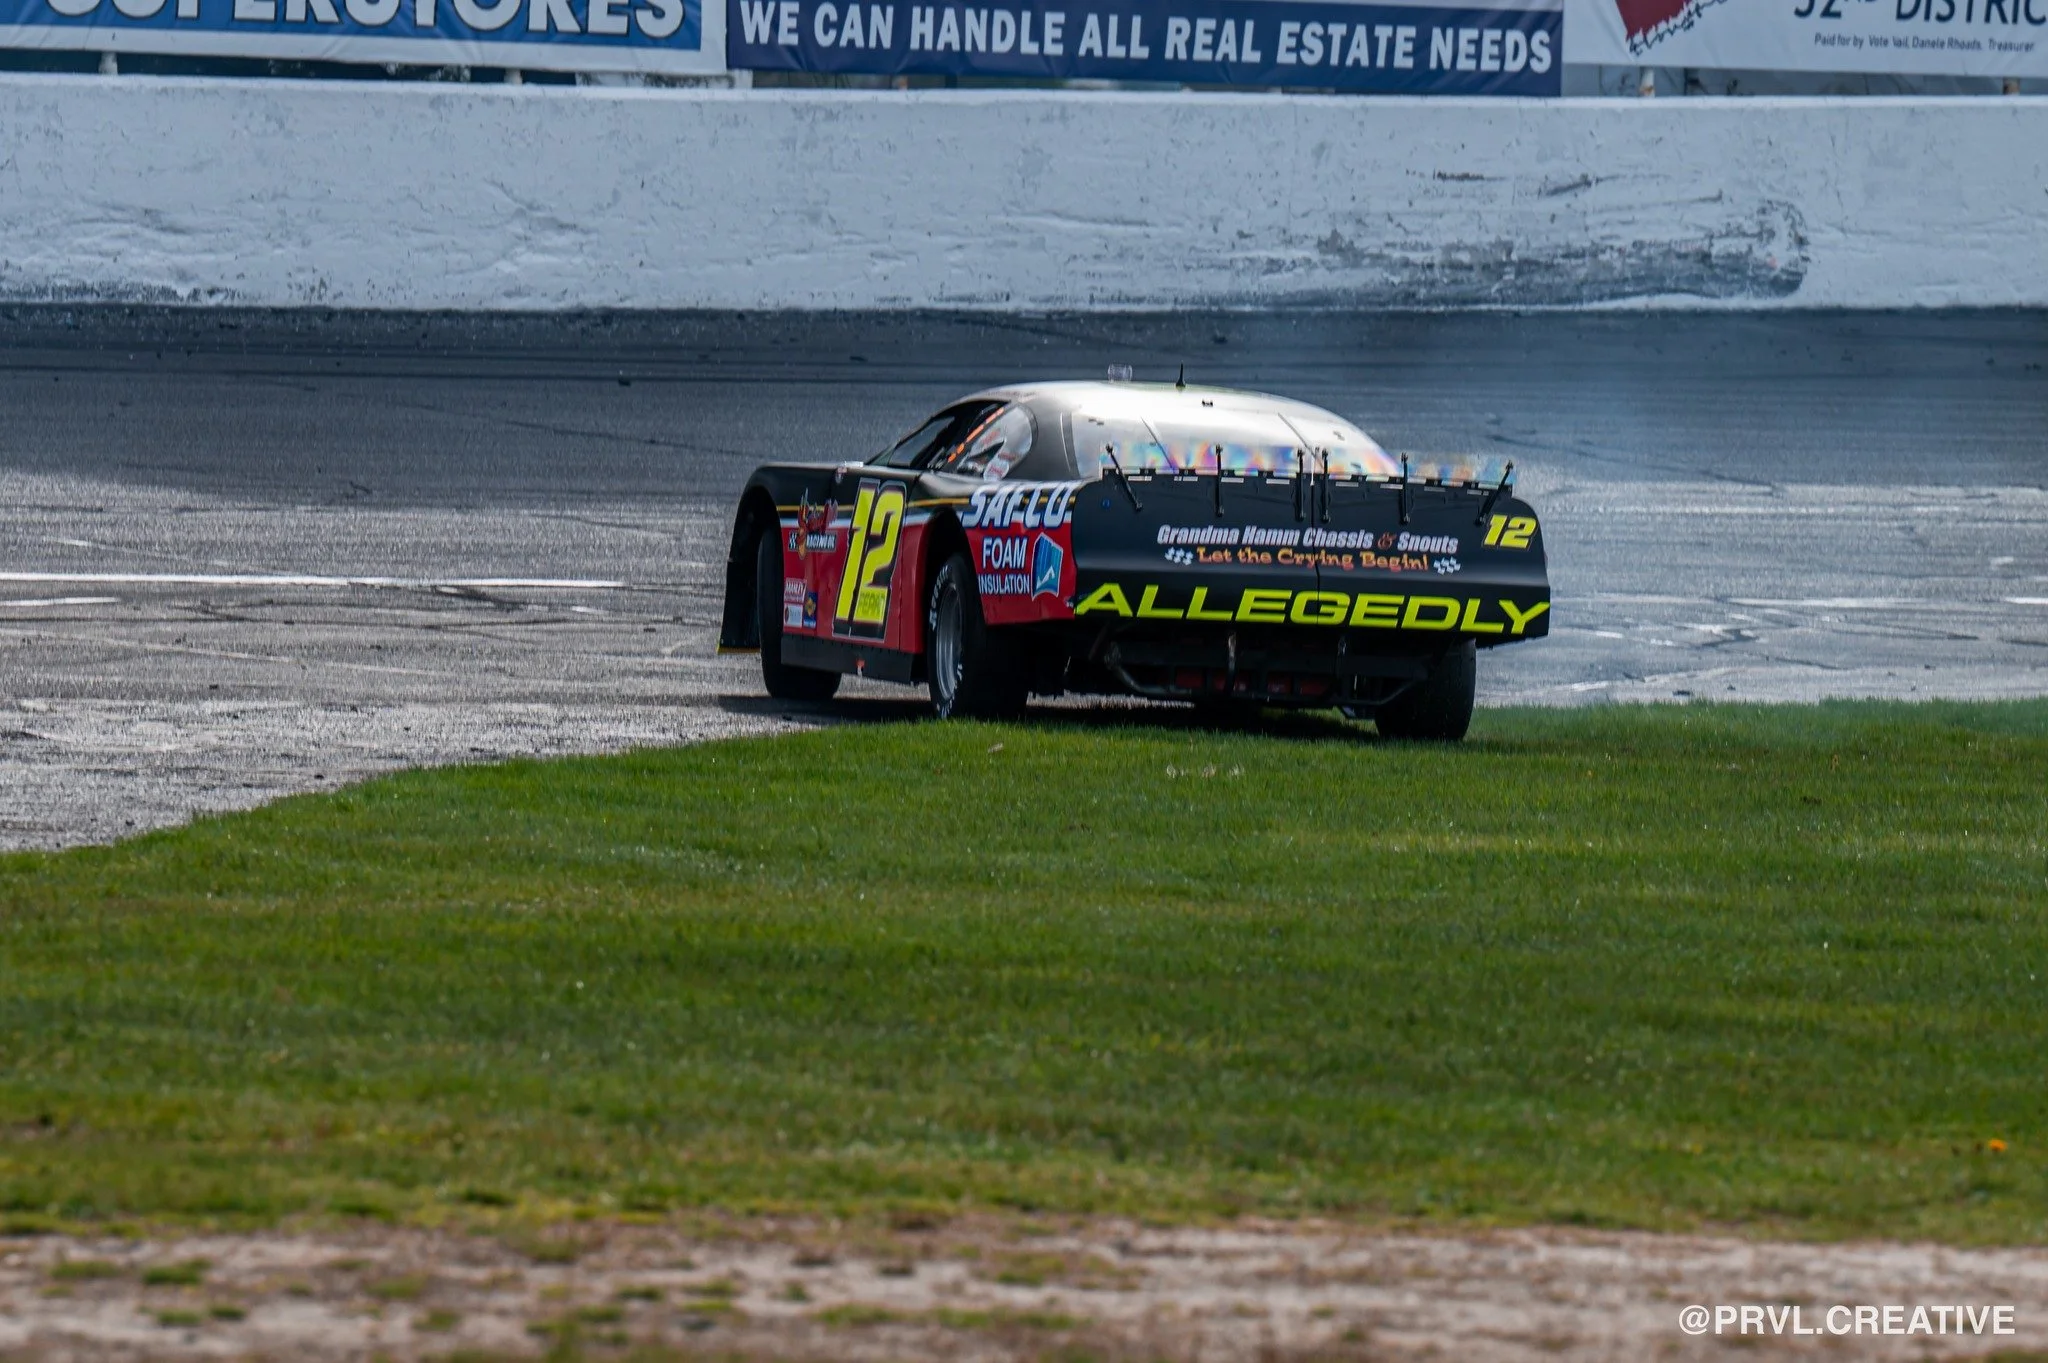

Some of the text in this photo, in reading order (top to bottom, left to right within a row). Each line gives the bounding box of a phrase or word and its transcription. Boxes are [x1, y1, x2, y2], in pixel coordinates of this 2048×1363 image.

[739, 0, 799, 46] WE
[813, 2, 894, 49] CAN
[910, 6, 1066, 56] HANDLE
[1078, 13, 1150, 59] ALL
[1164, 17, 1262, 63] REAL
[1276, 21, 1417, 69] ESTATE
[1429, 26, 1552, 74] NEEDS
[1814, 32, 1836, 47] Paid
[1837, 33, 1851, 47] for
[1852, 34, 1865, 50] by
[1868, 34, 1889, 48] Vote
[1156, 524, 1459, 554] Grandma Hamm Chassis & Snouts
[1483, 513, 1538, 550] 12
[834, 486, 906, 627] 12
[982, 537, 1028, 569] FOAM
[1196, 546, 1429, 573] Let the Crying Begin!
[978, 573, 1030, 594] INSULATION
[1074, 583, 1550, 634] ALLEGEDLY
